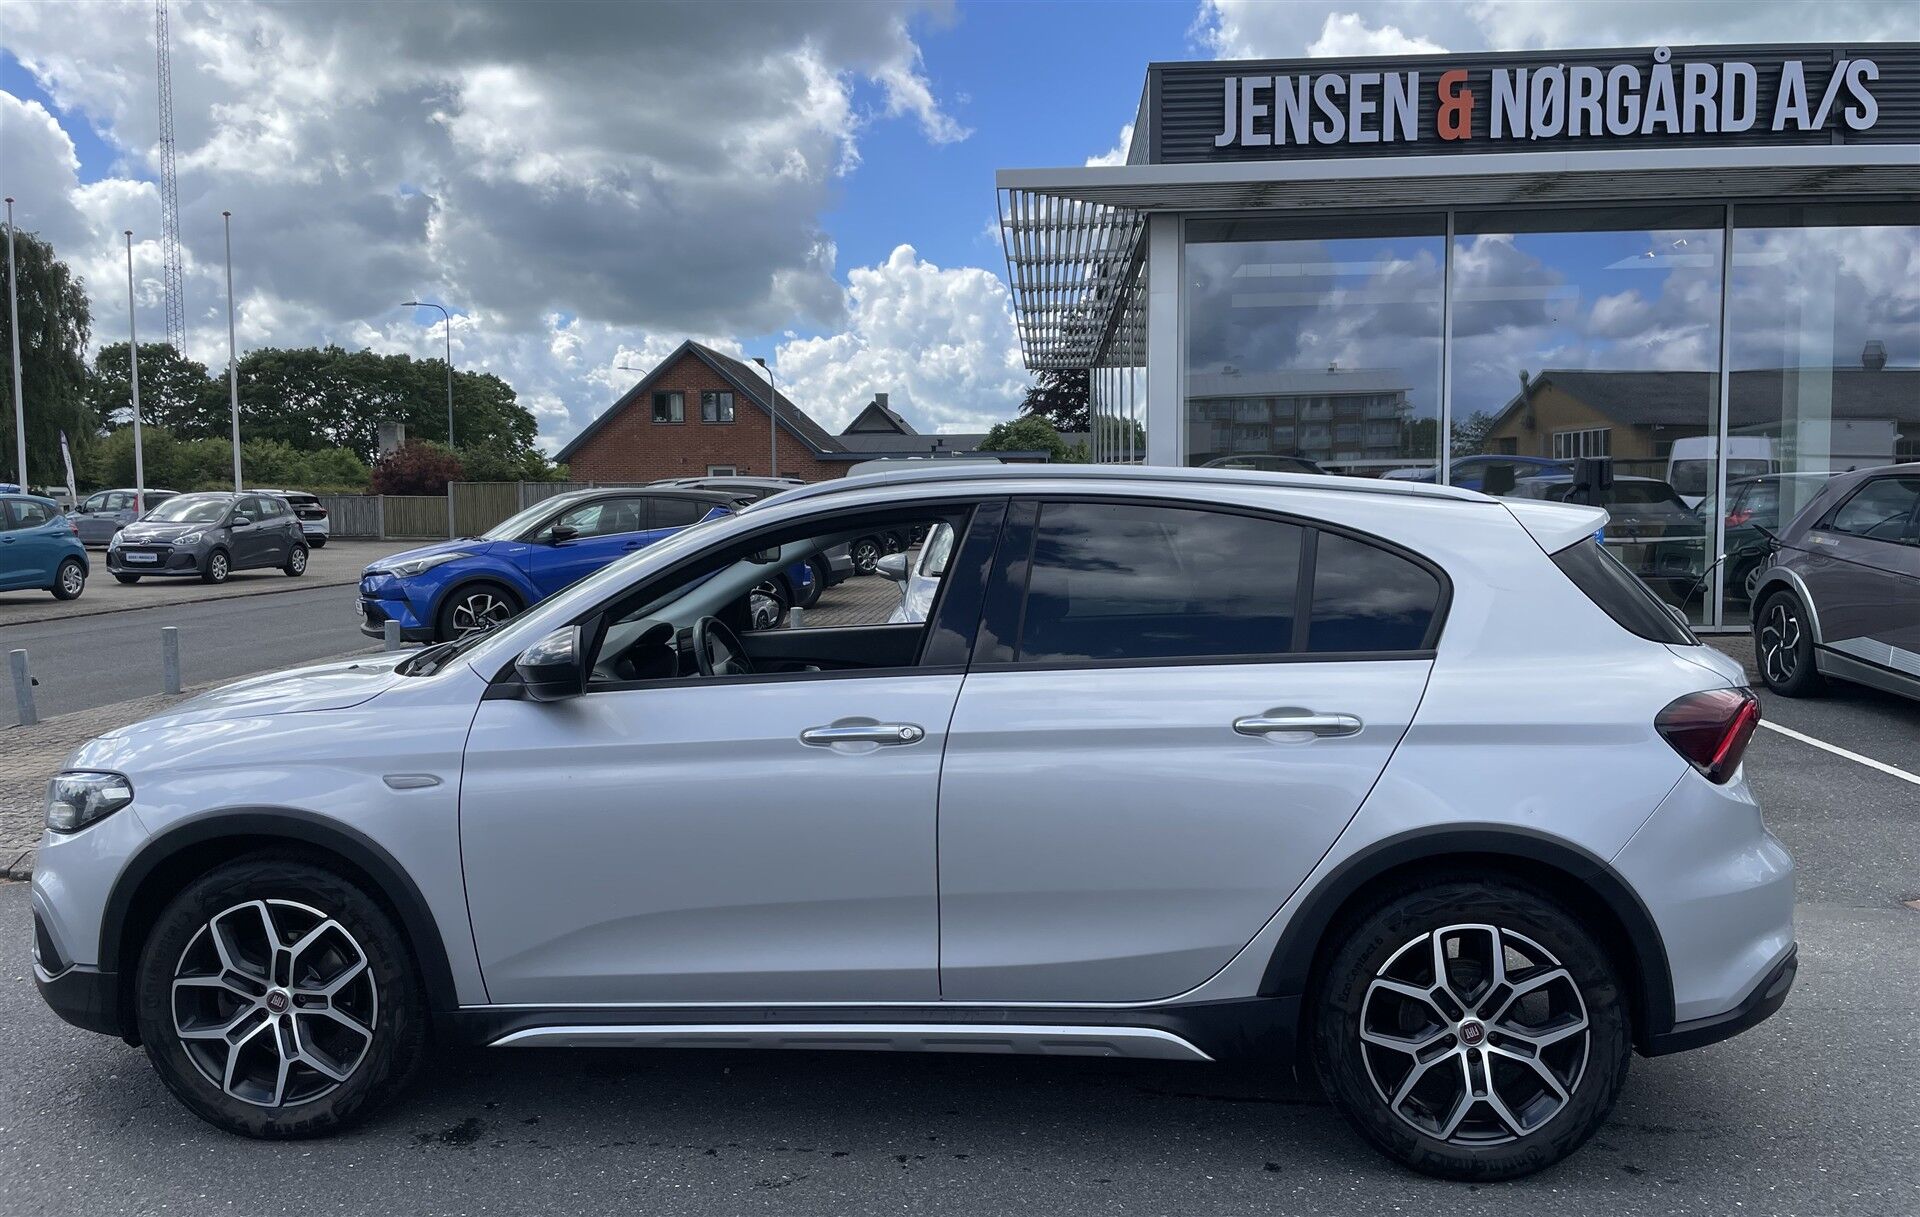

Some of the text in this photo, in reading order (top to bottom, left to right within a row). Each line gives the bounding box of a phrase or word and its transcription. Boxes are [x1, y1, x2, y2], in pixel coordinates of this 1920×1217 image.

[1215, 46, 1879, 146] JENSEN & NØRGÅRD A/S
[1464, 1025, 1480, 1040] FIAT
